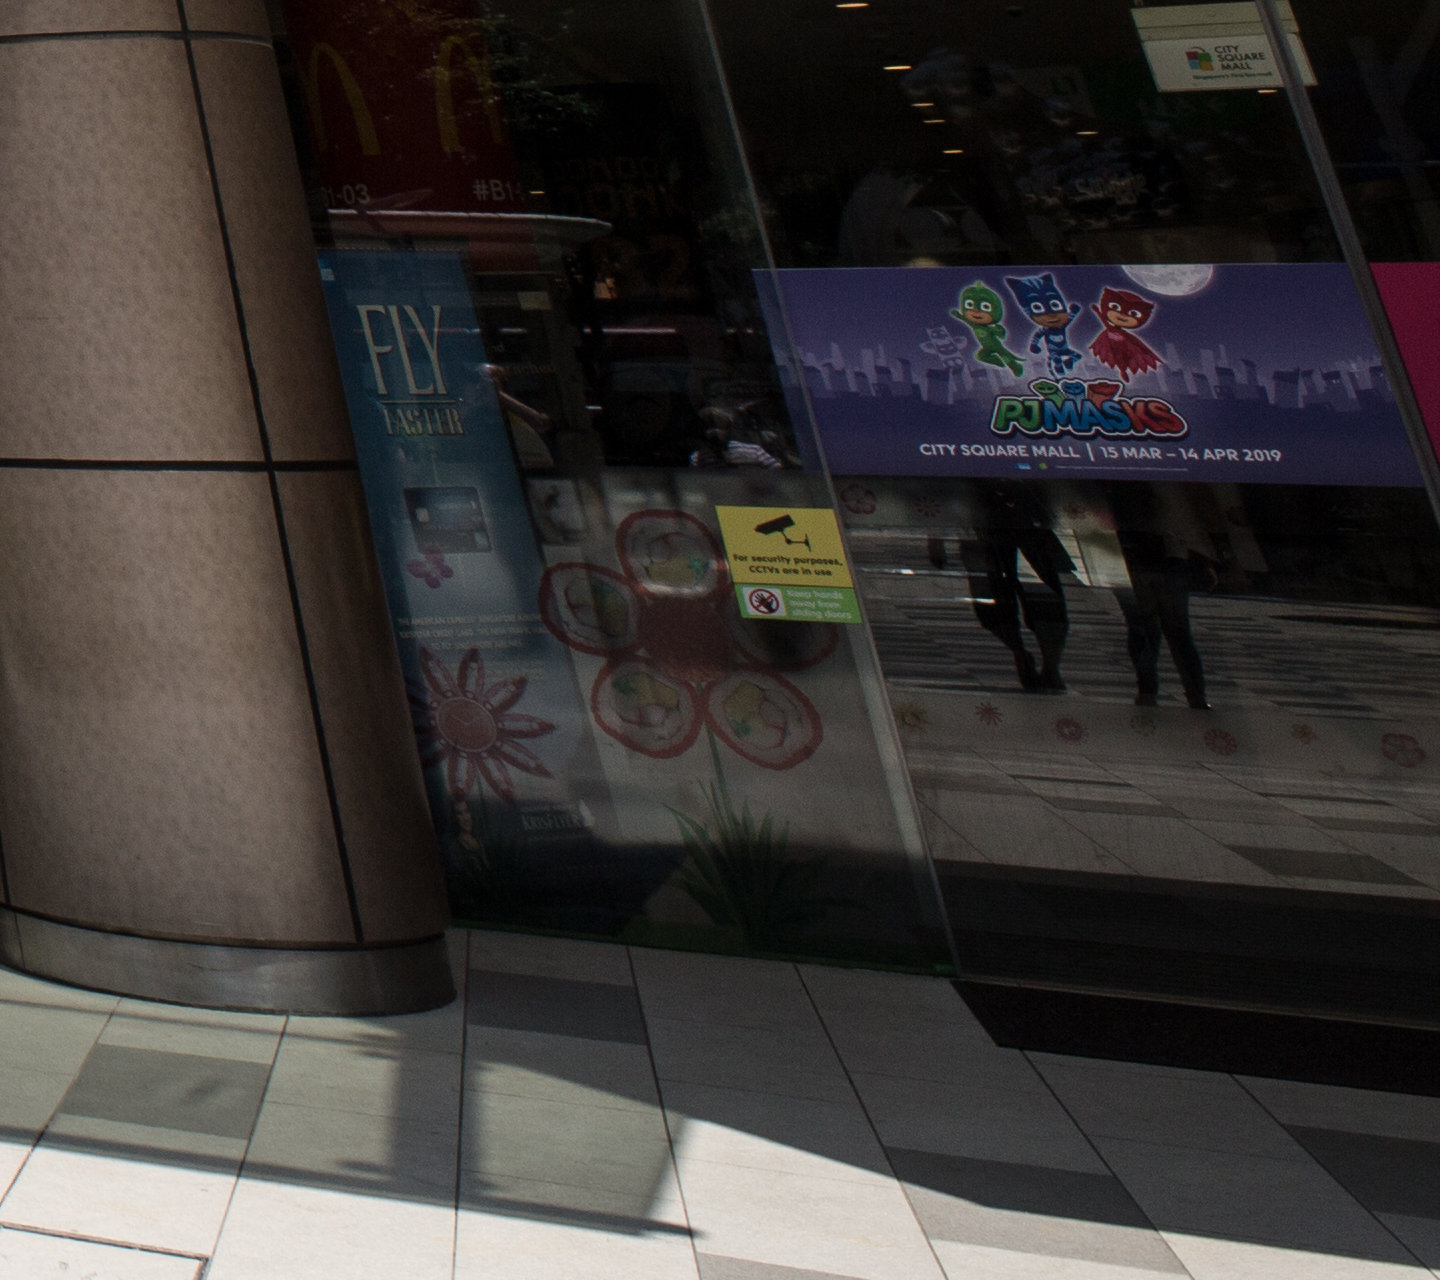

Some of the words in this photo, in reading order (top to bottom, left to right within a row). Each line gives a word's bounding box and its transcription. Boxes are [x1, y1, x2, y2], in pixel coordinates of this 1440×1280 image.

[1214, 45, 1239, 54] CITY
[1217, 52, 1266, 62] SQUARE
[1220, 62, 1253, 71] MALL
[355, 304, 450, 396] FLY
[1042, 397, 1188, 435] MASKS
[919, 443, 957, 456] CITY
[960, 444, 1030, 457] SQUARE
[1032, 445, 1081, 458] MALL
[1099, 446, 1118, 458] 15
[1122, 447, 1162, 460] MAR
[1179, 448, 1199, 460] 14
[1203, 448, 1239, 462] APR
[1242, 449, 1282, 462] 2019
[733, 554, 748, 562] For
[751, 555, 791, 565] security
[749, 565, 780, 574] CCTVs
